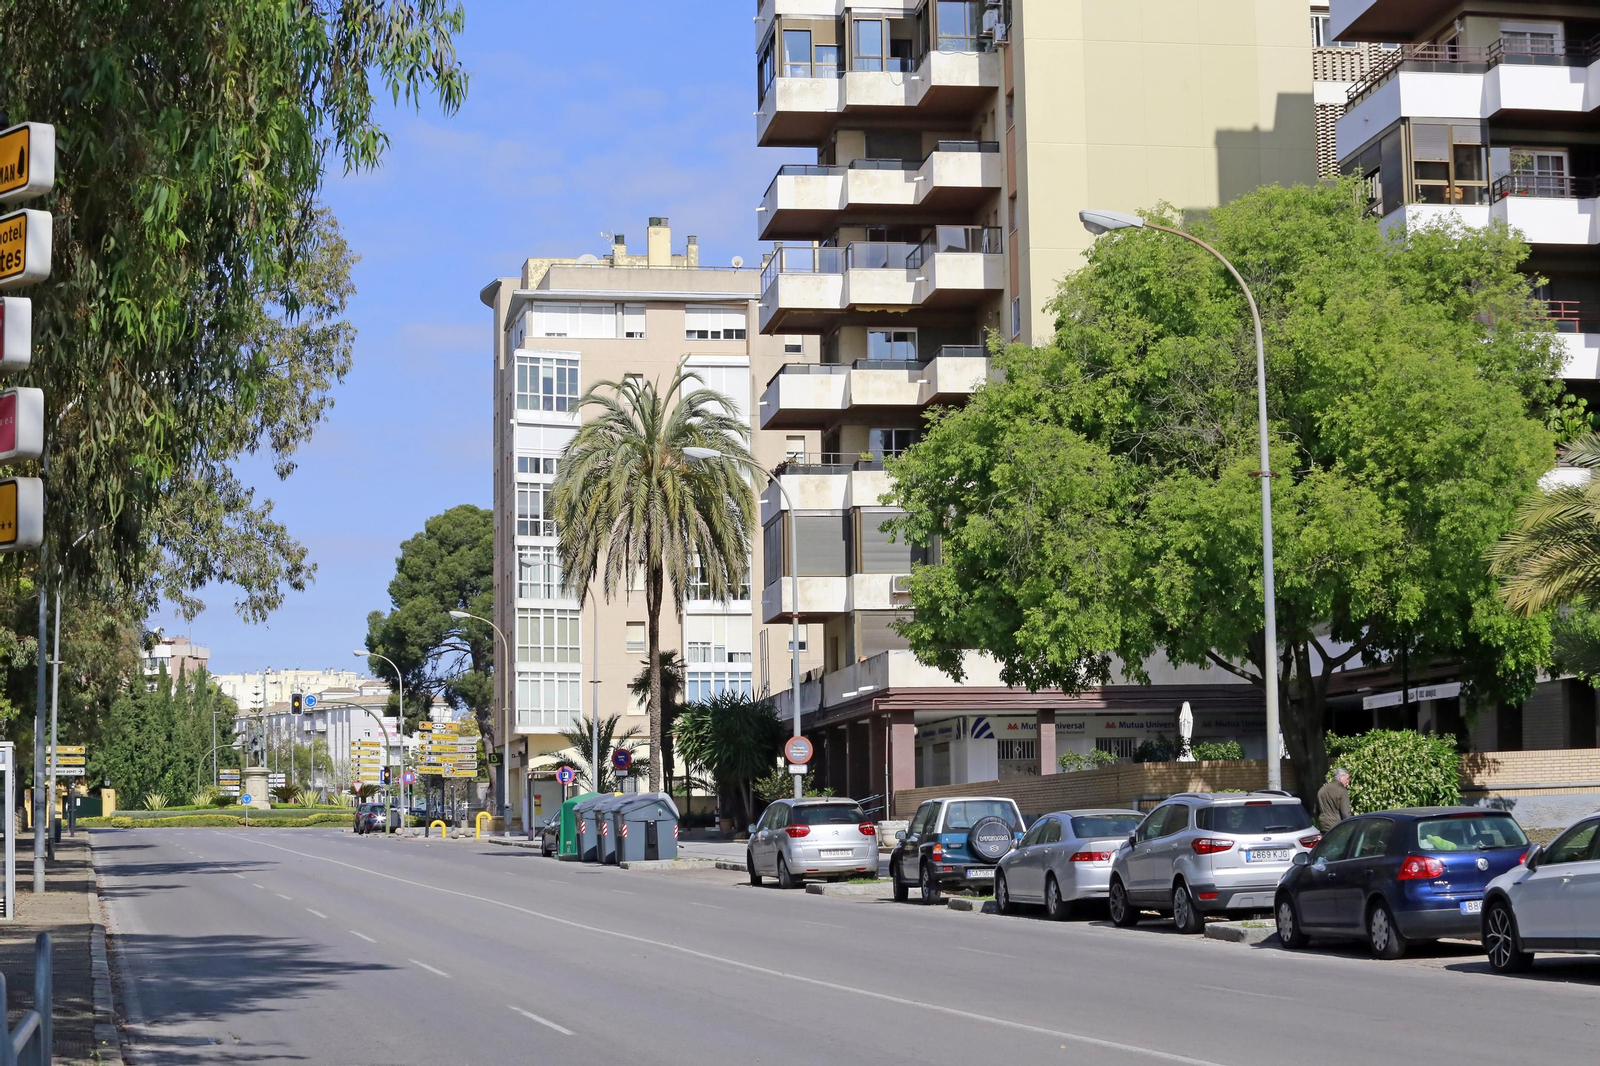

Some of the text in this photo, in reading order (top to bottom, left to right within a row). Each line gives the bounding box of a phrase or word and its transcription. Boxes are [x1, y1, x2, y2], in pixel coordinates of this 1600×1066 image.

[1055, 721, 1085, 730] niversal
[1118, 721, 1175, 729] Mutua Univers
[1272, 849, 1288, 858] KJG
